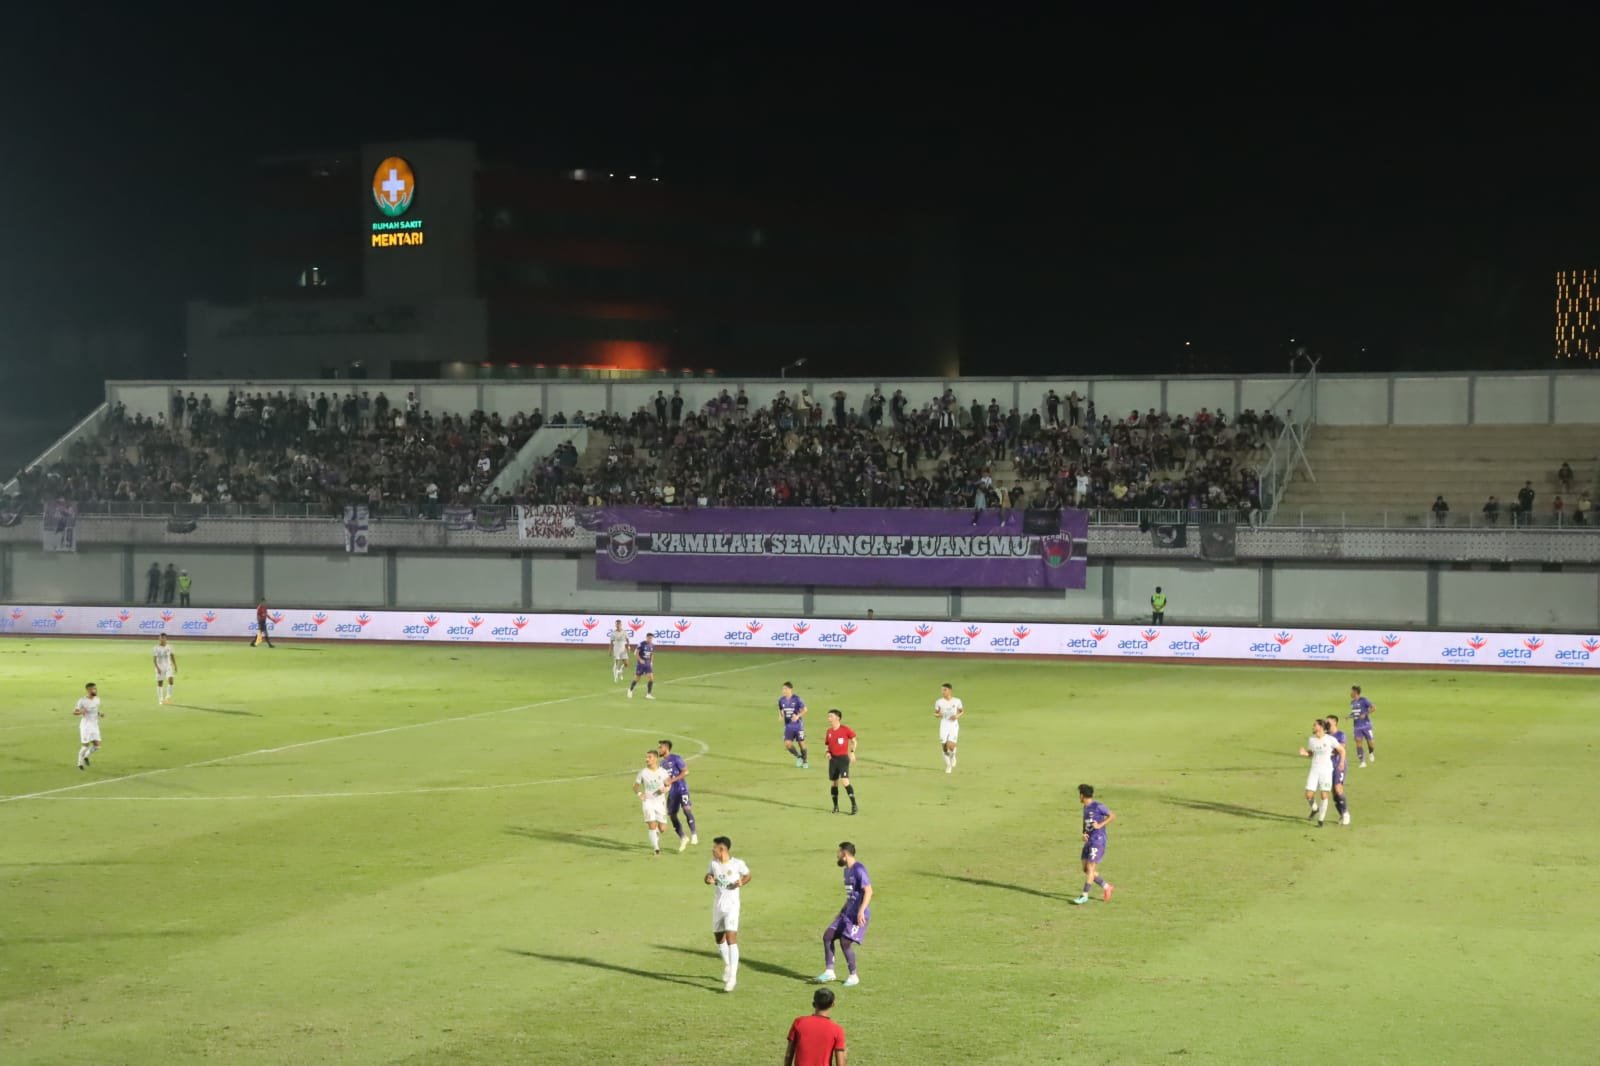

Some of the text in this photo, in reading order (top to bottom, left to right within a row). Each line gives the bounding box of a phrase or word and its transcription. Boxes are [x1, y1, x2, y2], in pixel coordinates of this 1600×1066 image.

[400, 220, 422, 228] SAKIT
[371, 232, 423, 247] MENTARI
[650, 533, 1029, 557] KAMILAH SEMANGAT JUANGMU
[97, 619, 122, 629] aetra
[139, 619, 165, 630] aetra
[182, 620, 208, 630] aetra
[291, 622, 318, 632] aetra
[335, 623, 362, 633] aetra
[403, 624, 430, 634] aetra
[447, 625, 474, 635] aetra
[491, 626, 519, 636] aetra
[560, 626, 589, 637] aetra
[653, 629, 681, 639] aetra
[724, 630, 752, 640] aetra
[770, 632, 800, 642] aetra
[818, 632, 848, 642] aetra
[892, 634, 922, 644] aetra
[941, 635, 970, 645] aetra
[990, 636, 1020, 646] aetra
[1066, 638, 1098, 648] aetra
[1118, 638, 1148, 649] aetra
[1168, 640, 1200, 650] aetra
[1250, 642, 1282, 652] aetra
[1302, 643, 1334, 654] aetra
[1356, 644, 1389, 654] aetra
[1442, 646, 1475, 657] aetra
[1498, 648, 1532, 658] aetra
[1554, 649, 1590, 660] aetra
